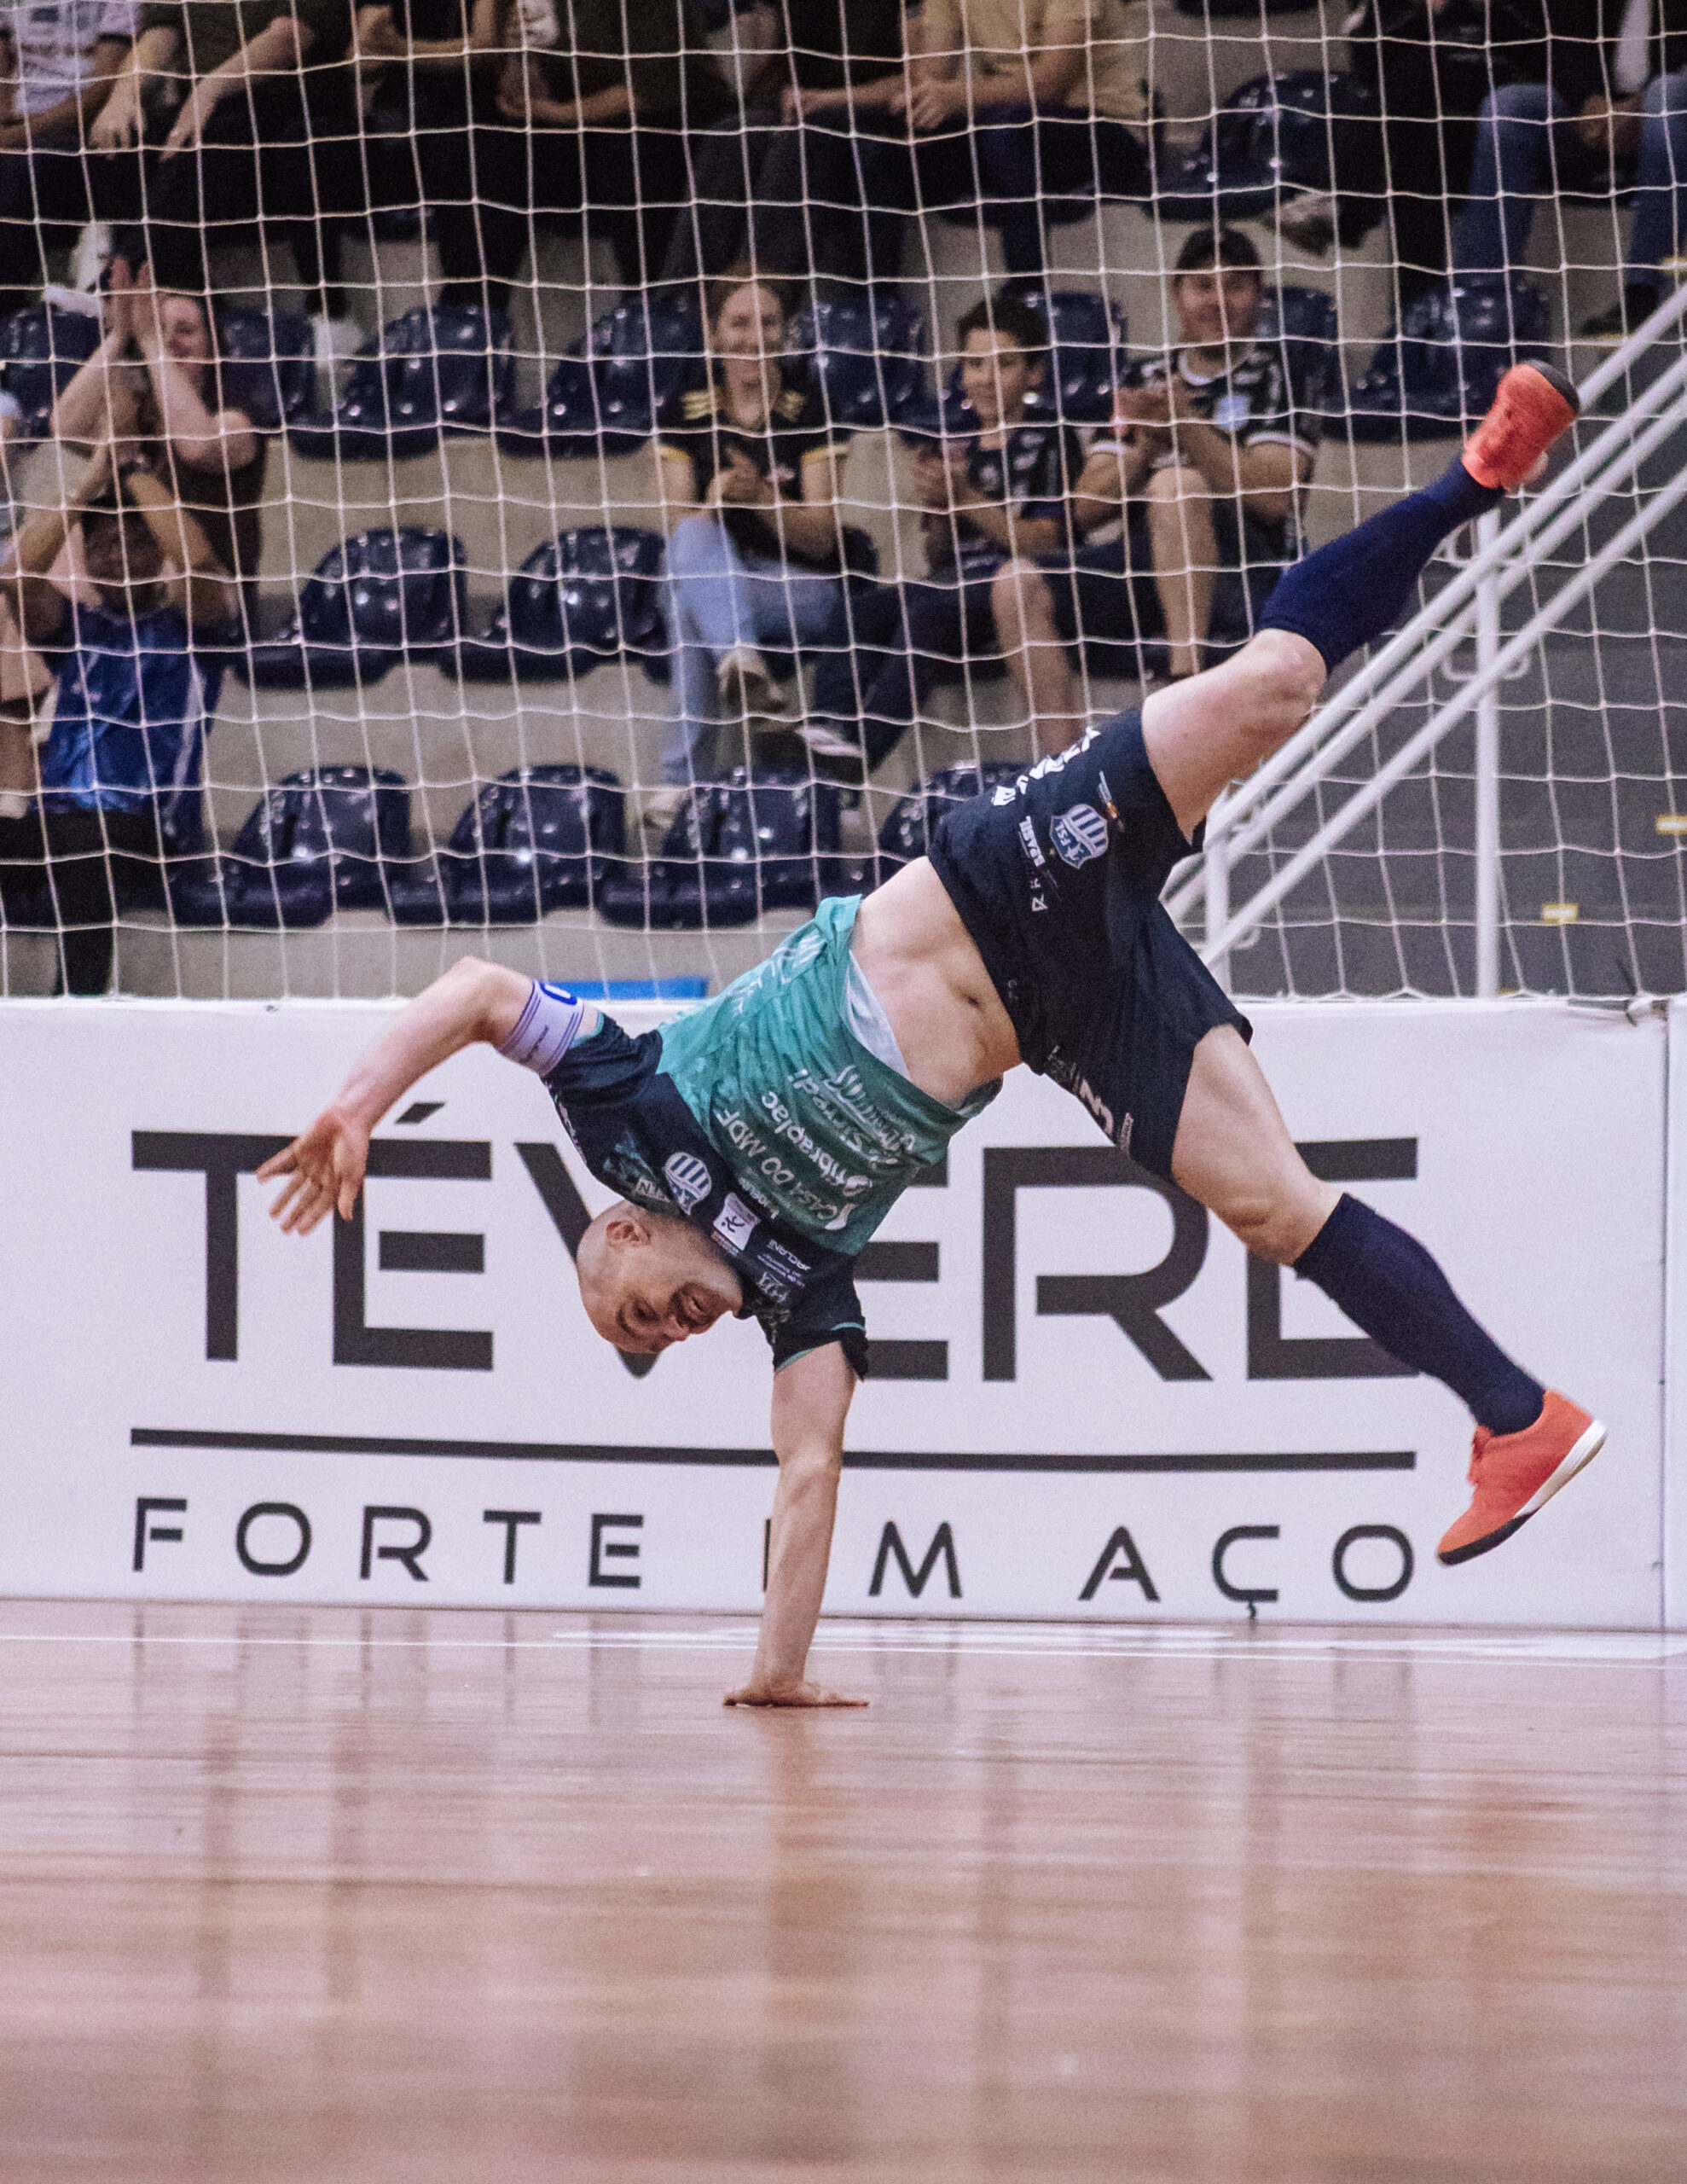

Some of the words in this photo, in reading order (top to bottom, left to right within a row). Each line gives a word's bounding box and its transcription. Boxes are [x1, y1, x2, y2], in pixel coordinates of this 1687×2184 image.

[1055, 822, 1071, 846] FSL
[715, 1110, 766, 1157] MDF
[761, 1090, 849, 1187] fibraplac
[759, 1157, 795, 1184] DO
[789, 1180, 838, 1223] CASA
[133, 1497, 644, 1587] FORTE
[762, 1519, 962, 1598] M
[1078, 1525, 1414, 1620] AÇO
